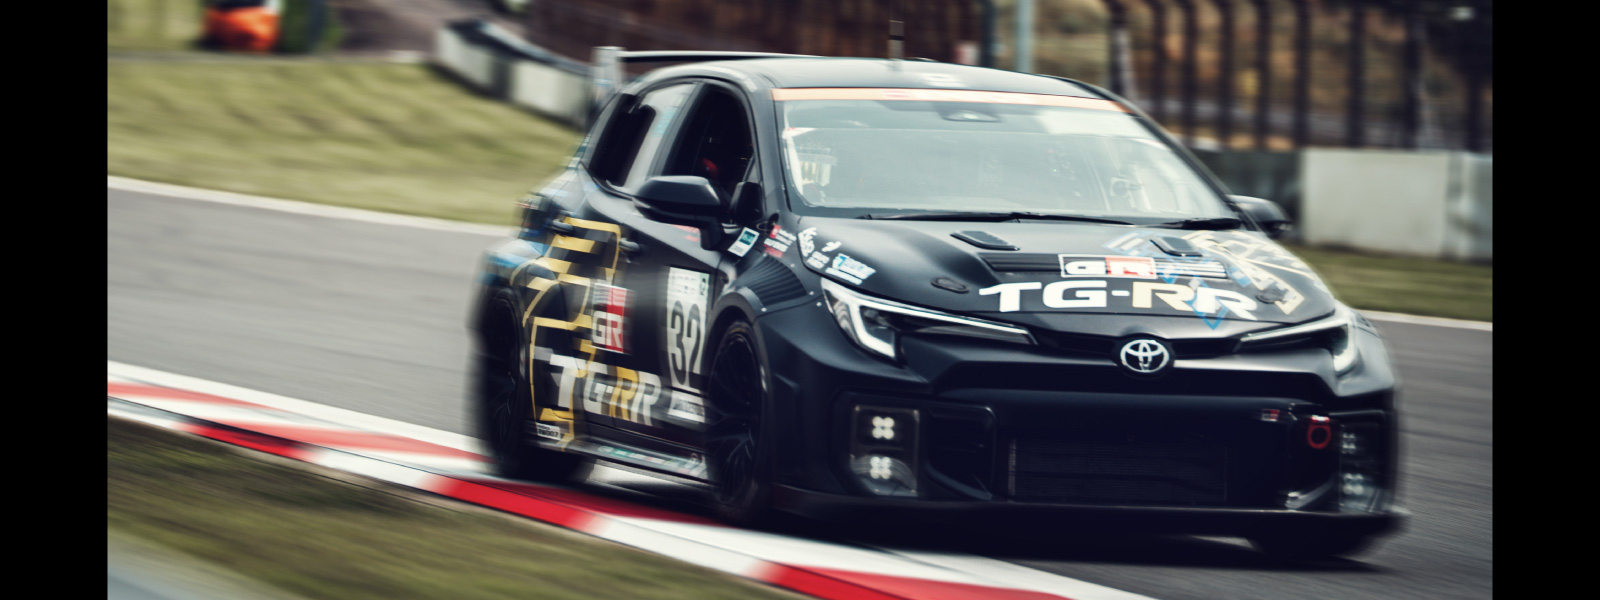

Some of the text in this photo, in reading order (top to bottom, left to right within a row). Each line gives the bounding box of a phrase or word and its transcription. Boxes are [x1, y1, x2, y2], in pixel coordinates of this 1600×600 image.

[1064, 260, 1154, 276] GR
[979, 280, 1258, 321] TG-RR
[592, 310, 624, 350] GR
[670, 300, 702, 388] 32
[549, 353, 662, 427] TG-RR
